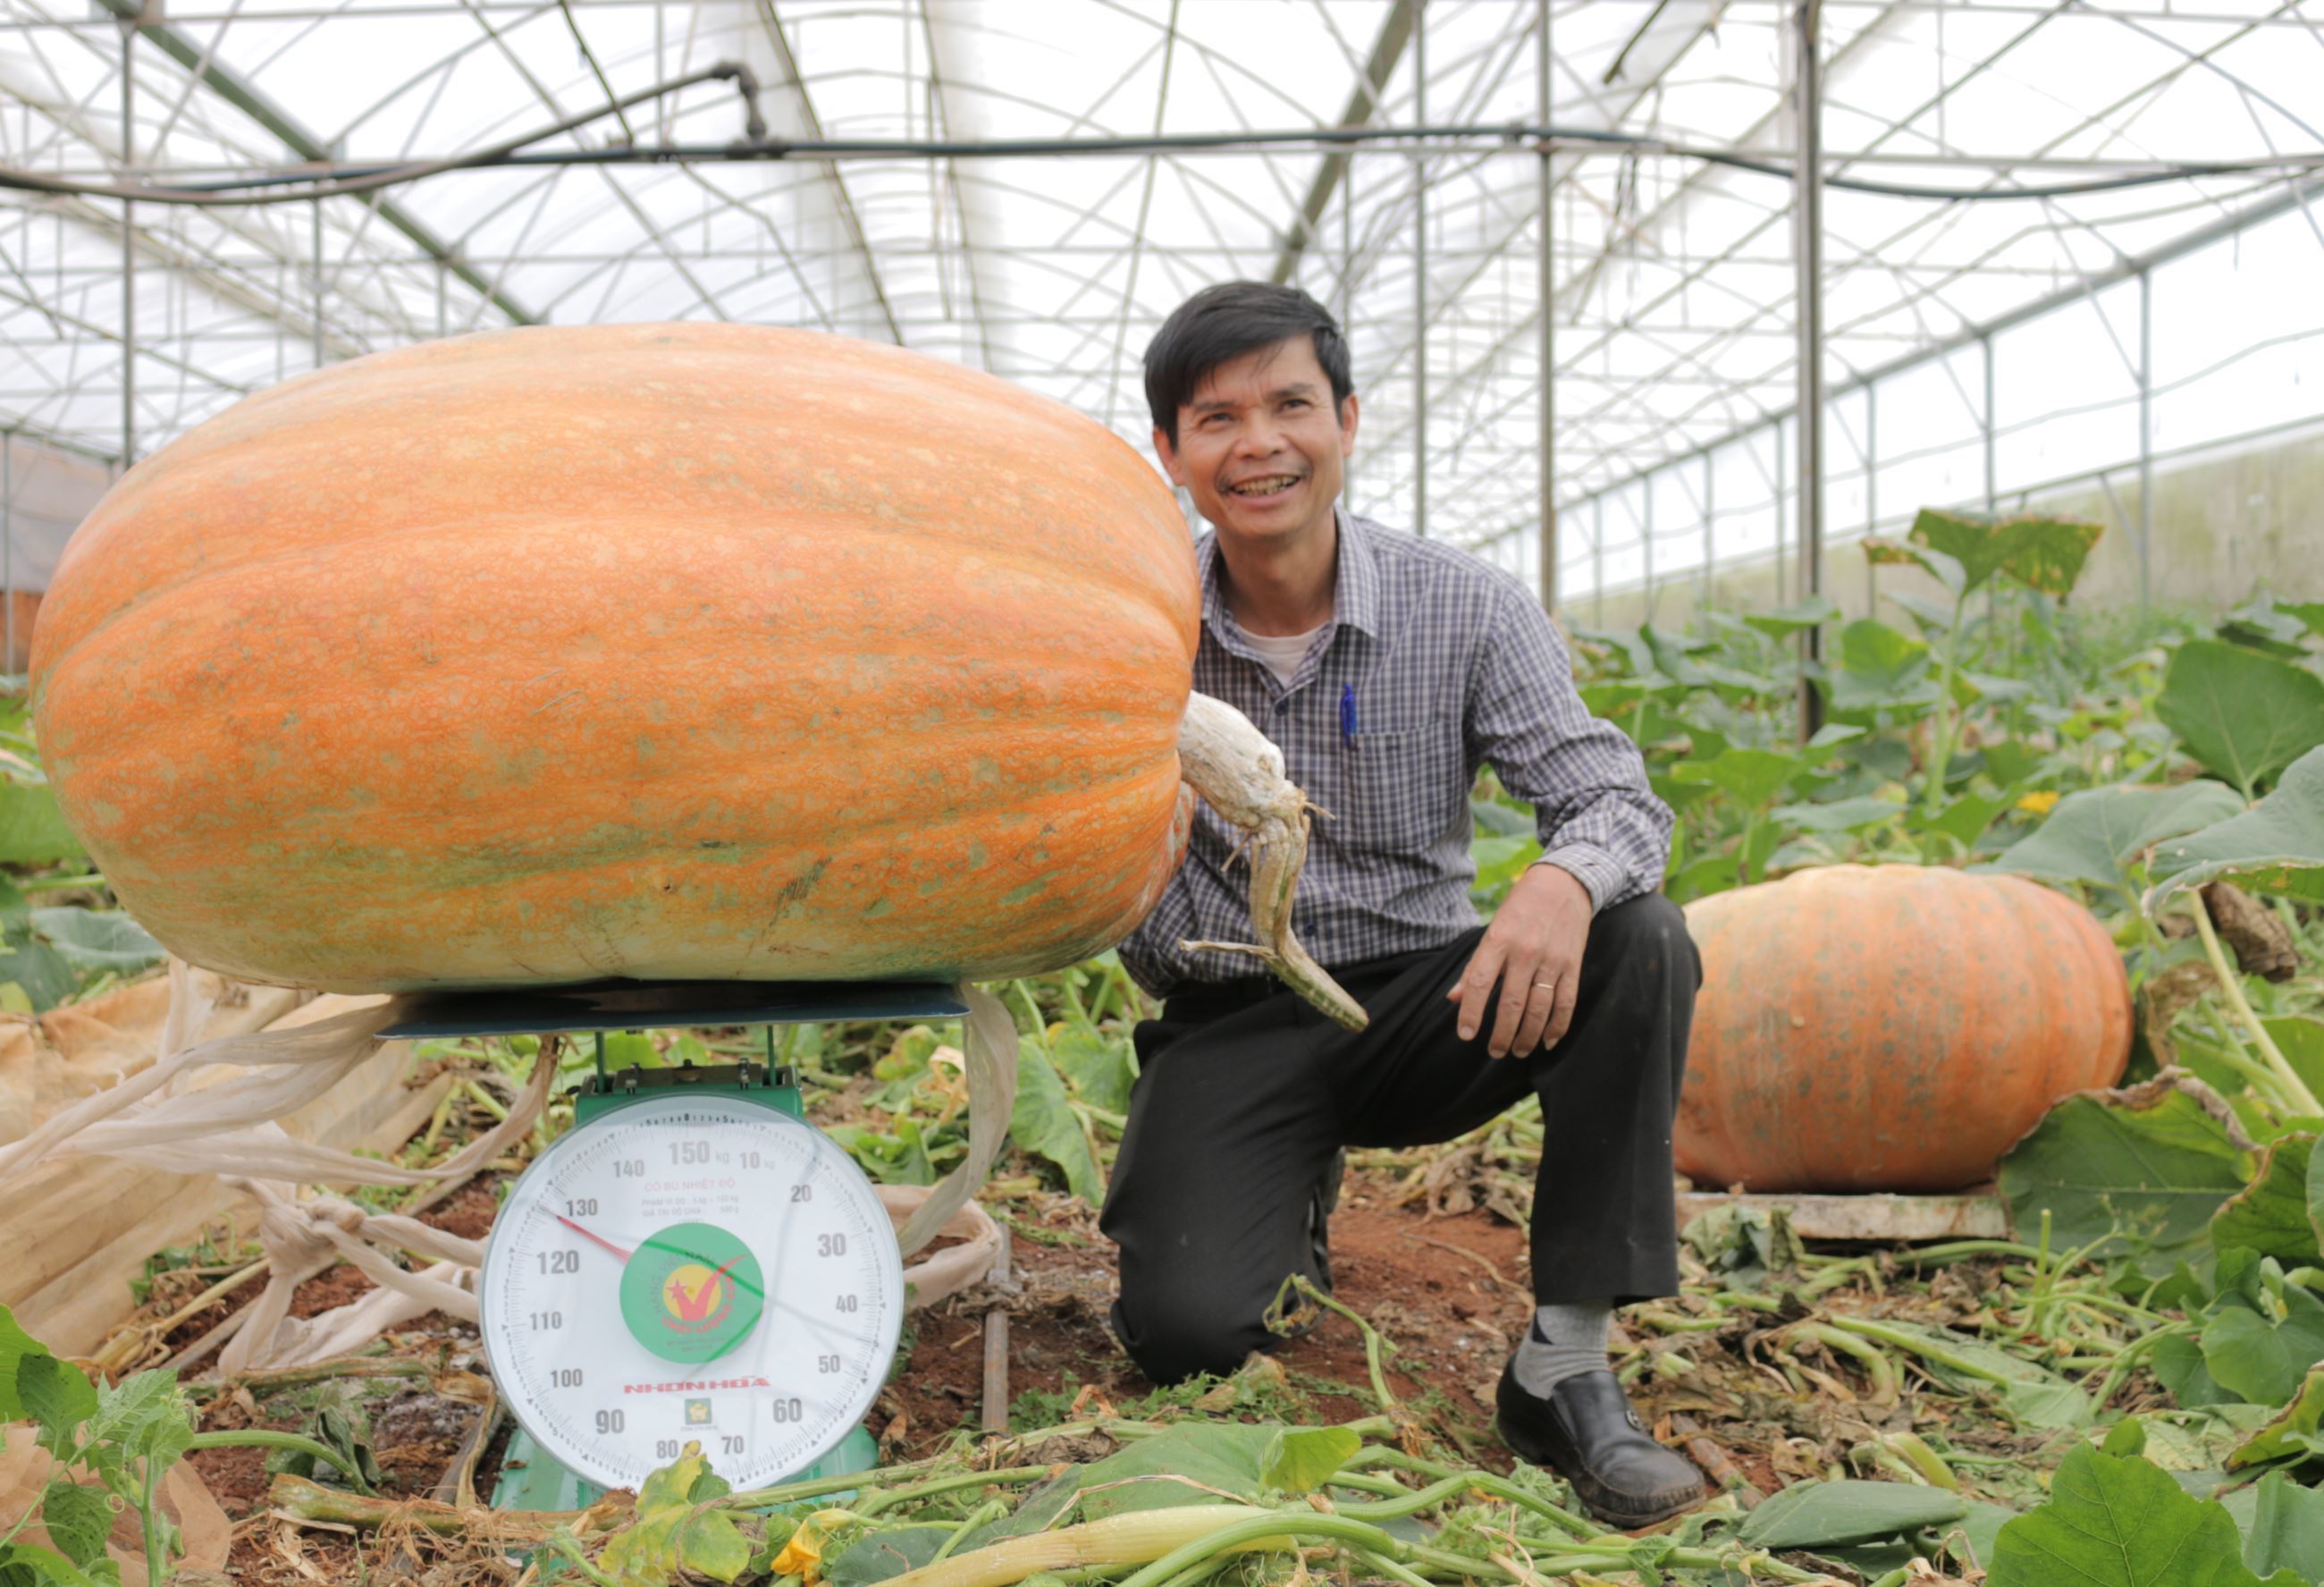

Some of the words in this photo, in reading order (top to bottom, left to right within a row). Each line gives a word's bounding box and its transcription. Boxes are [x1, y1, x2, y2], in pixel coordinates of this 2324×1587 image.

[668, 1141, 711, 1164] 150
[715, 1151, 729, 1165] kg
[739, 1152, 760, 1169] 10
[612, 1159, 644, 1178] 140
[790, 1184, 813, 1203] 20
[566, 1198, 599, 1218] 130
[818, 1232, 846, 1257] 30
[536, 1250, 580, 1274] 120
[836, 1295, 858, 1313] 40
[530, 1312, 562, 1330] 110
[818, 1355, 841, 1374] 50
[551, 1368, 583, 1388] 100
[772, 1398, 803, 1423] 60
[594, 1409, 625, 1434] 90
[656, 1439, 678, 1459] 80
[721, 1435, 745, 1455] 70
